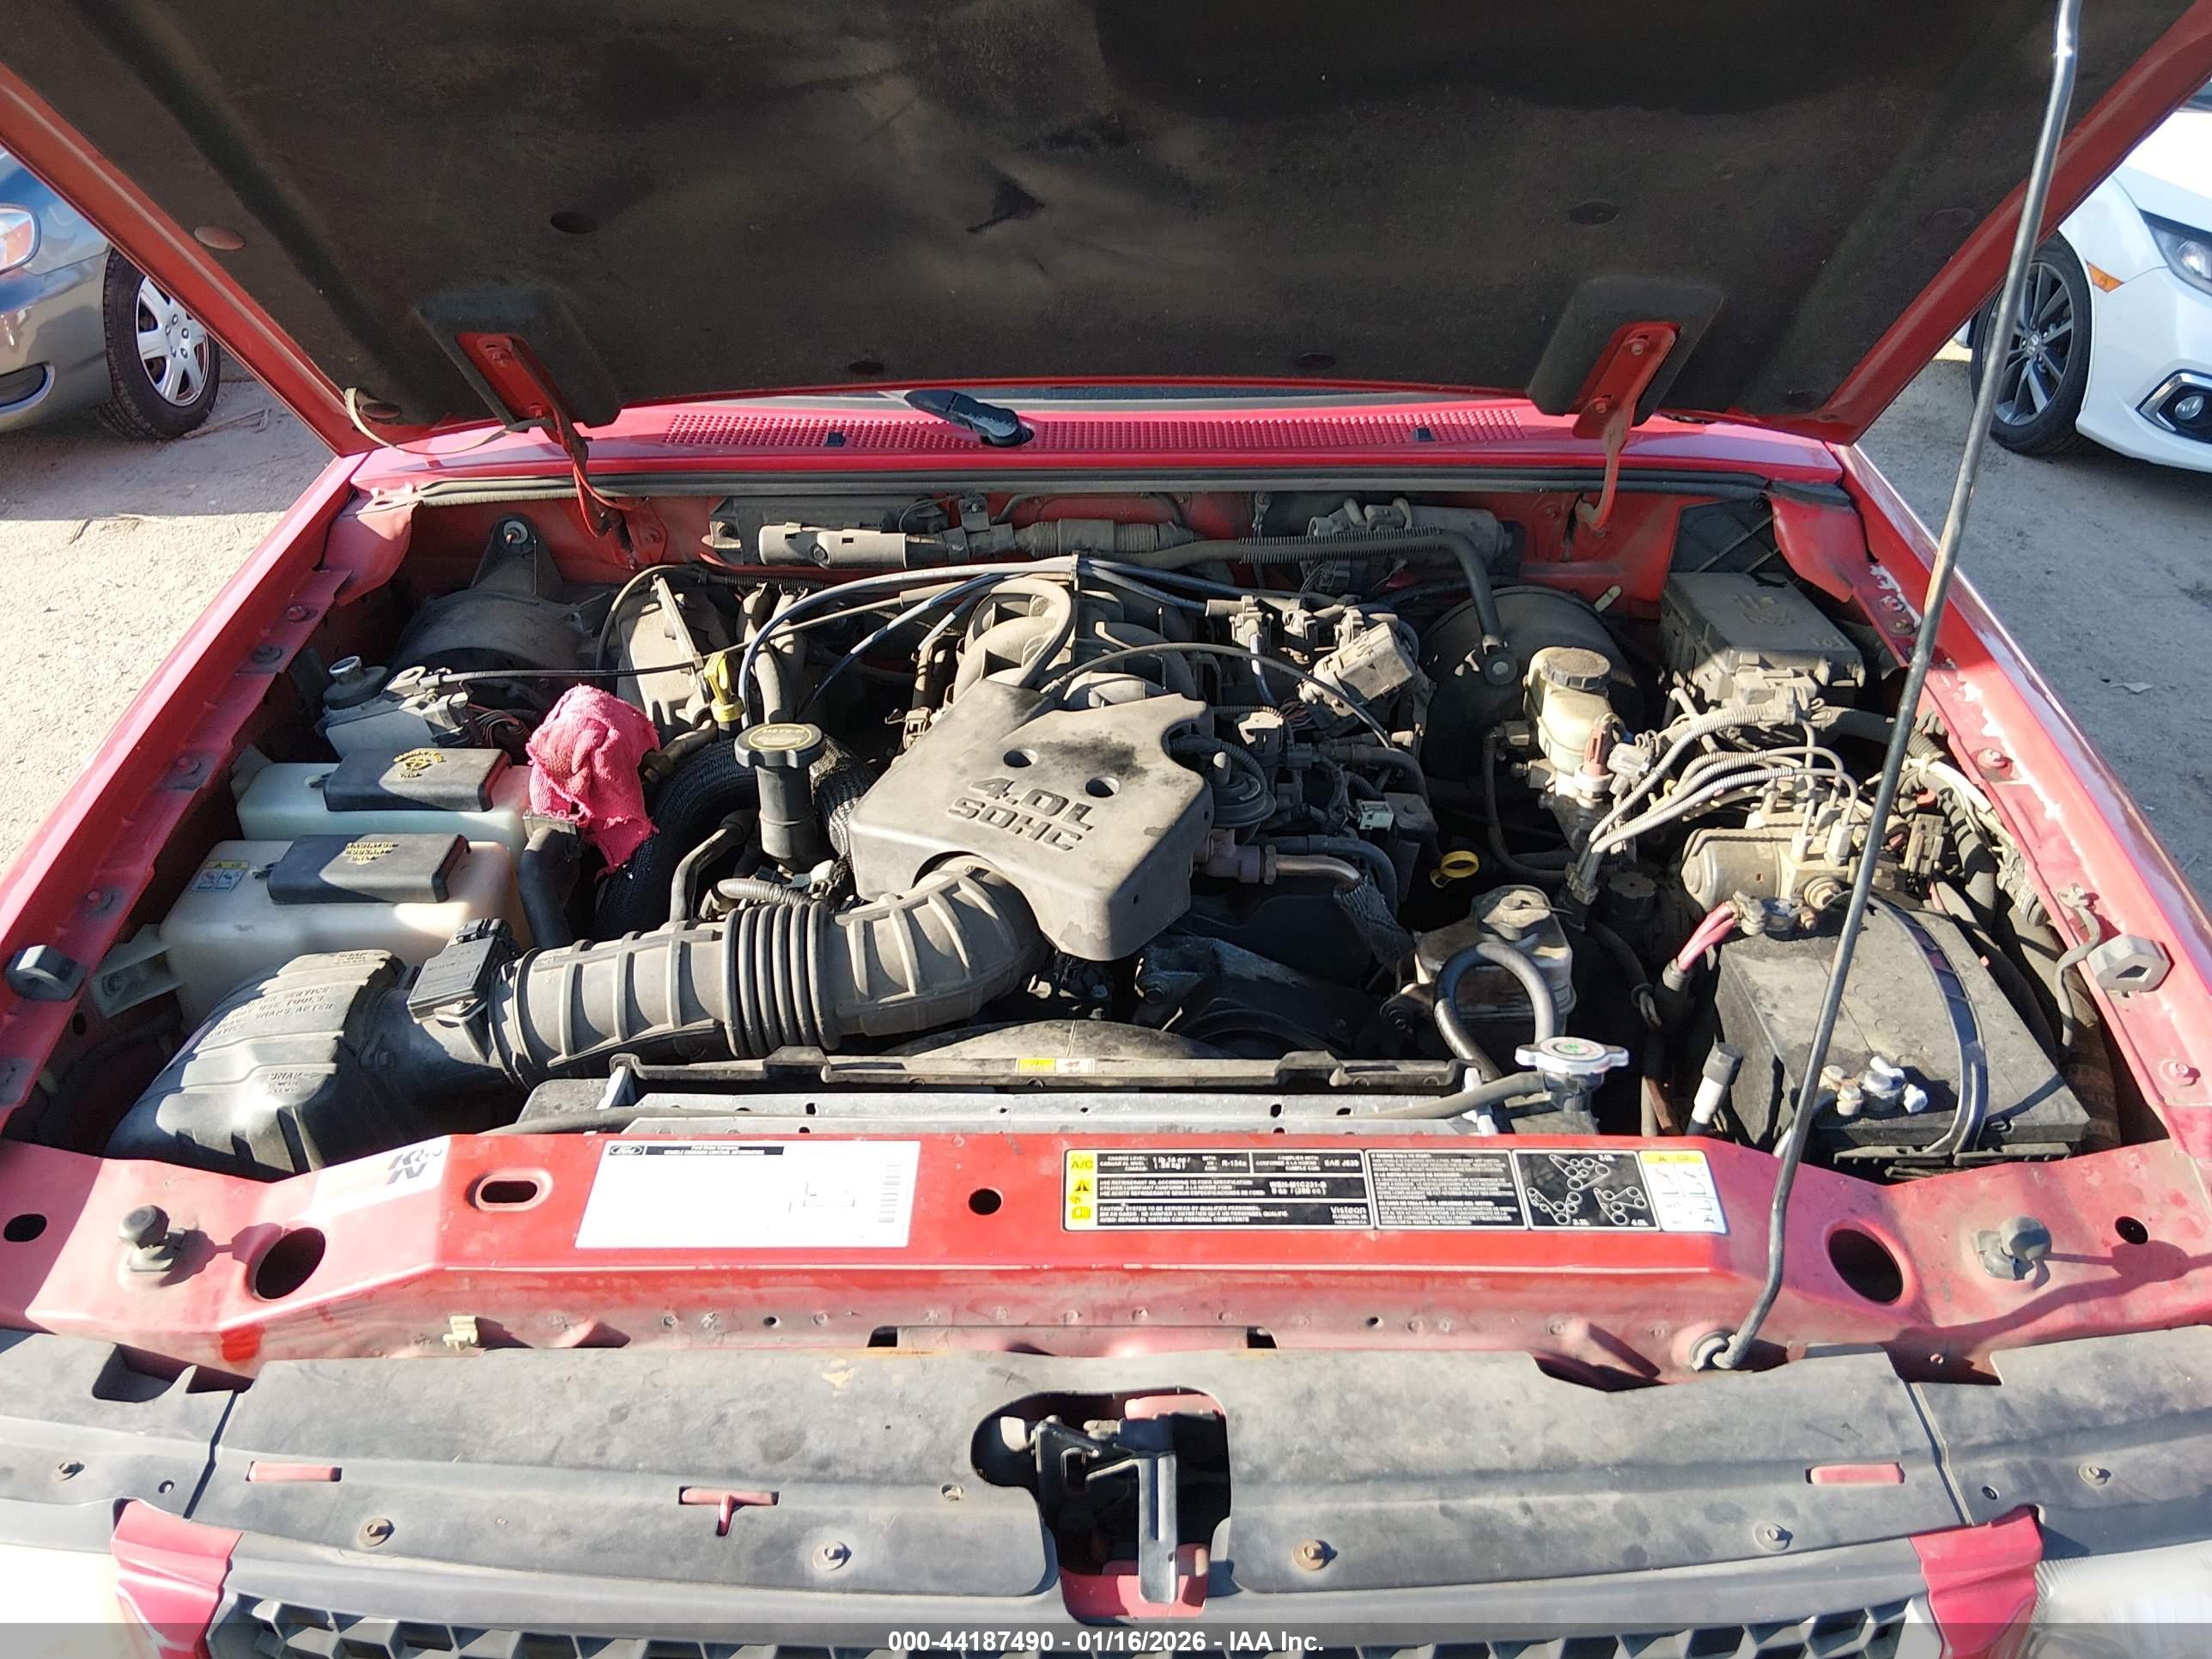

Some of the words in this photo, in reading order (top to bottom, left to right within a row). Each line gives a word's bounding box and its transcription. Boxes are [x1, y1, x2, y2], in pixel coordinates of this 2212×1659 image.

[947, 796, 1084, 851] SOHC
[969, 775, 1094, 831] 4.0L
[1329, 1206, 1367, 1214] Visteon
